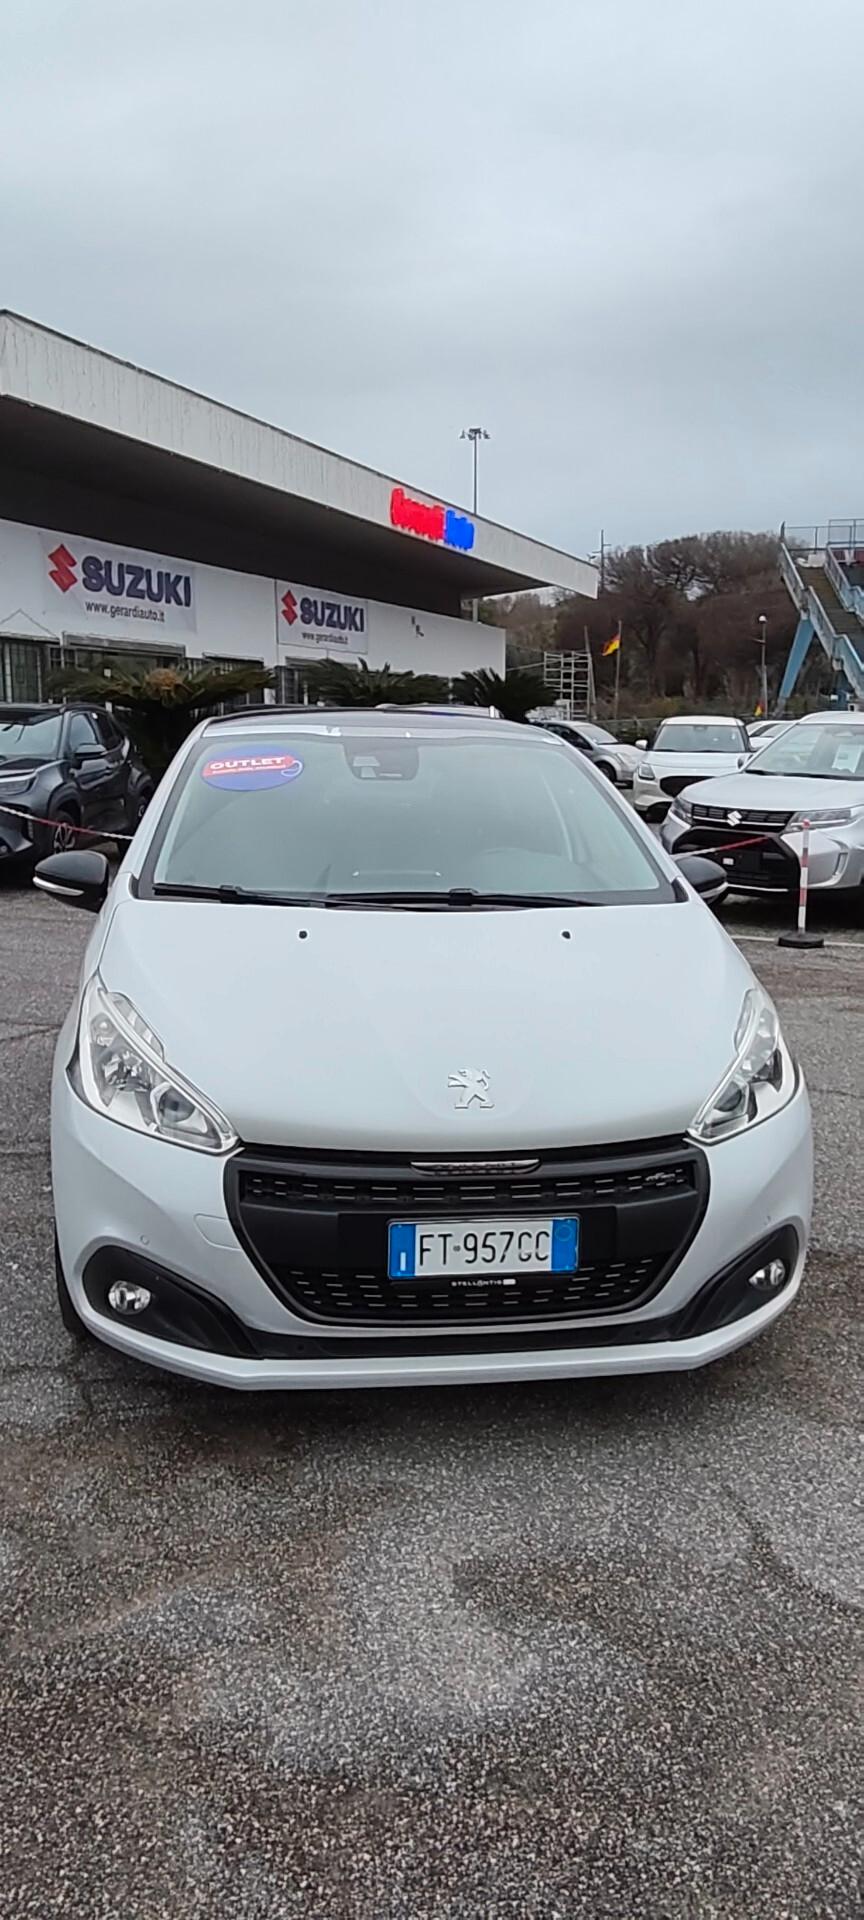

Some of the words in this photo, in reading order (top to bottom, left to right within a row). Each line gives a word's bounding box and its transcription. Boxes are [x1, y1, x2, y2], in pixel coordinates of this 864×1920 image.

[81, 555, 192, 608] SUZUKI
[85, 600, 165, 623] www.gerardiauto.it
[300, 597, 365, 633] SUZUKI
[210, 756, 286, 770] OUTLET
